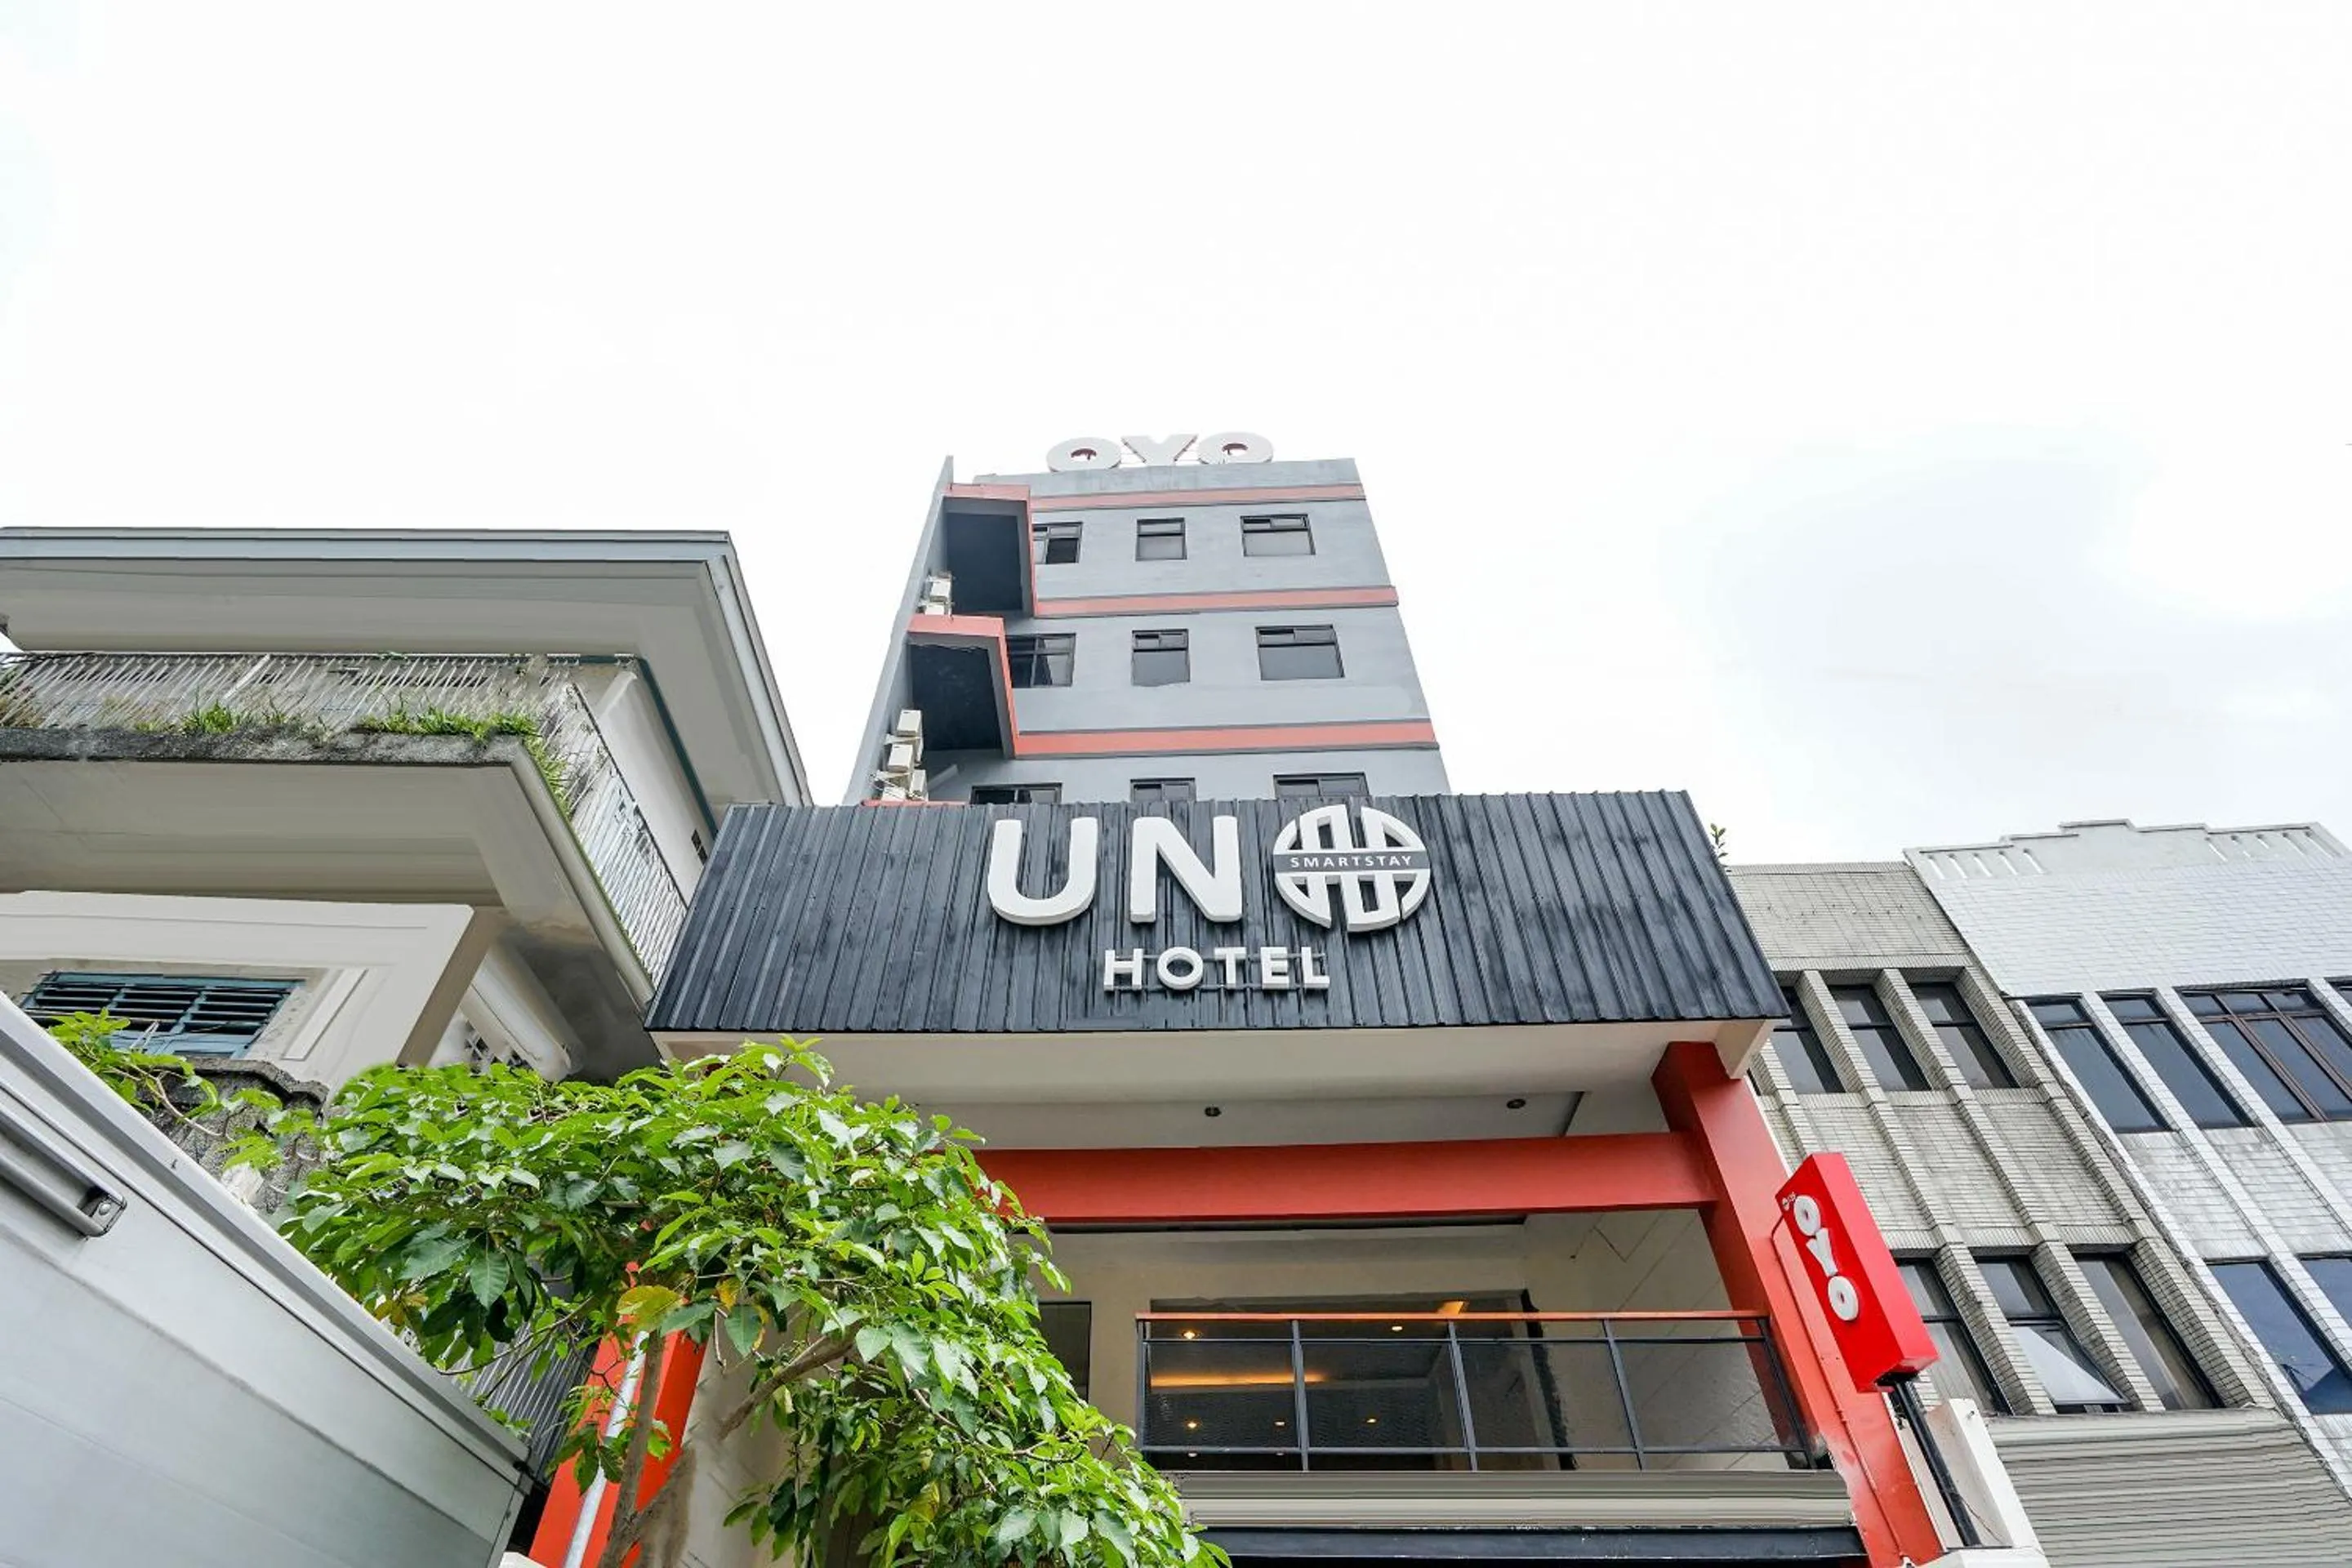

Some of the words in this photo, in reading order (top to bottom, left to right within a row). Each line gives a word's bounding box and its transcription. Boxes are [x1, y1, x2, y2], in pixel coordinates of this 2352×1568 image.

[1046, 432, 1273, 472] OYO
[1290, 855, 1412, 868] SMARTSTAY
[1103, 947, 1330, 991] HOTEL
[1793, 1196, 1859, 1321] OYO
